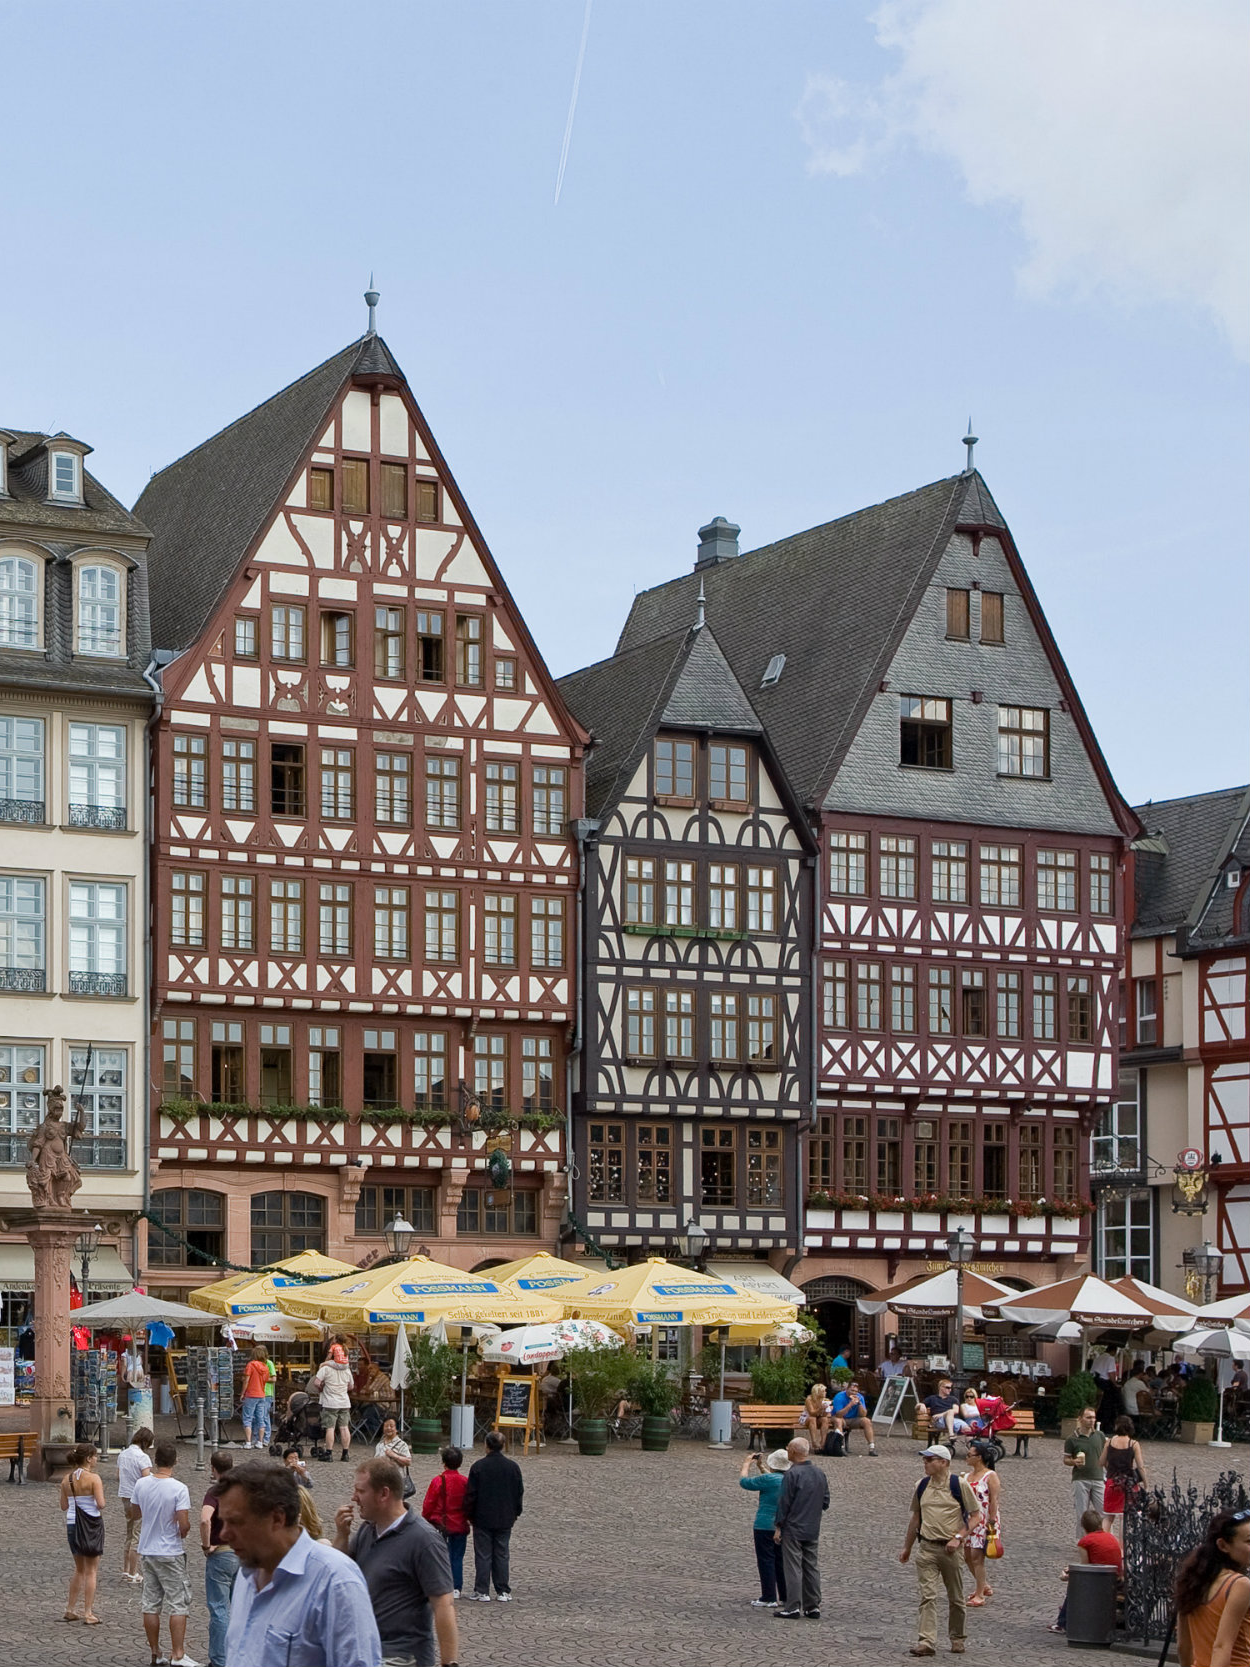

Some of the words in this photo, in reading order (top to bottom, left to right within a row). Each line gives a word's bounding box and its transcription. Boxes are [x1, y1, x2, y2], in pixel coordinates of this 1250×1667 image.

[3, 1282, 35, 1291] Andenke
[411, 1284, 488, 1293] POSSMANN
[662, 1286, 729, 1295] POSSMANN
[376, 1313, 419, 1322] POSSMANN
[448, 1311, 473, 1319] Selbst
[642, 1313, 679, 1321] POSSMANN
[738, 1311, 751, 1319] und
